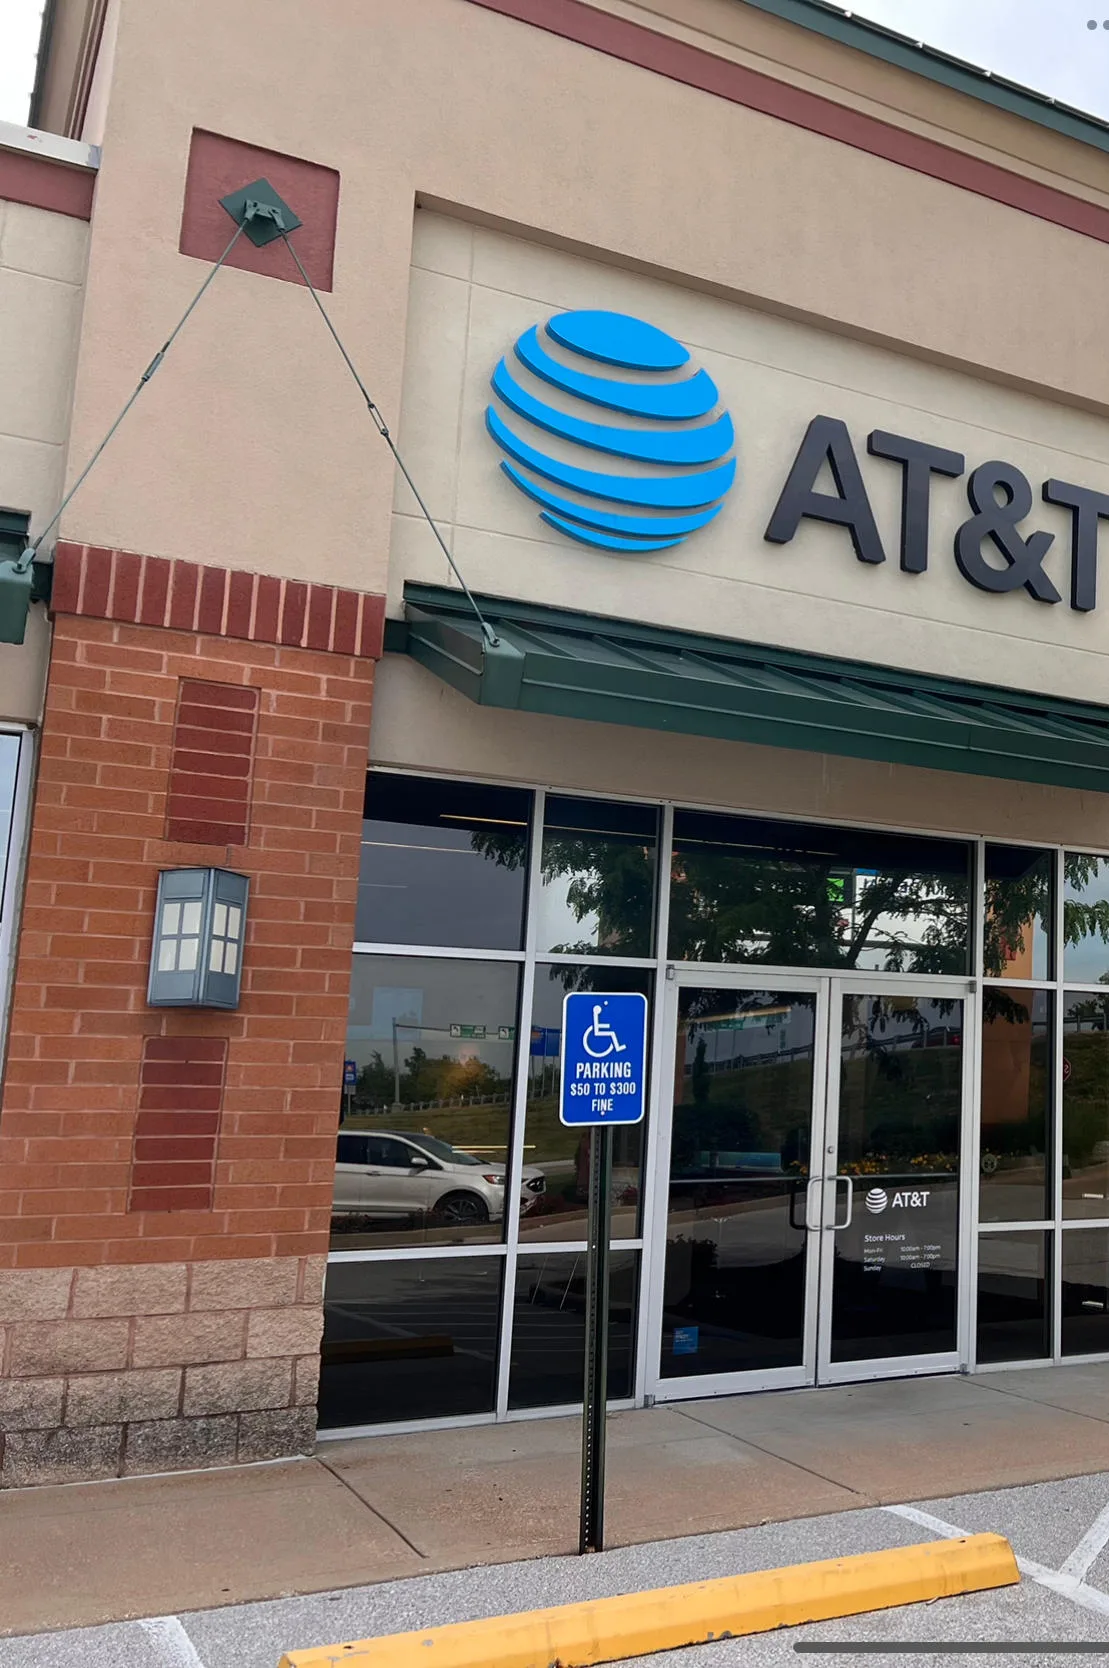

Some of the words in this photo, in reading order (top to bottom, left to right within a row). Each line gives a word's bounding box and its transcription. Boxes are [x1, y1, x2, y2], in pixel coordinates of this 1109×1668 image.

[576, 1062, 632, 1079] PARKING
[570, 1083, 590, 1096] $50
[594, 1083, 606, 1095] TO
[610, 1082, 636, 1095] $300
[591, 1099, 613, 1112] FINE
[891, 1191, 930, 1208] AT&T
[864, 1234, 884, 1242] Store
[885, 1233, 905, 1241] Hours
